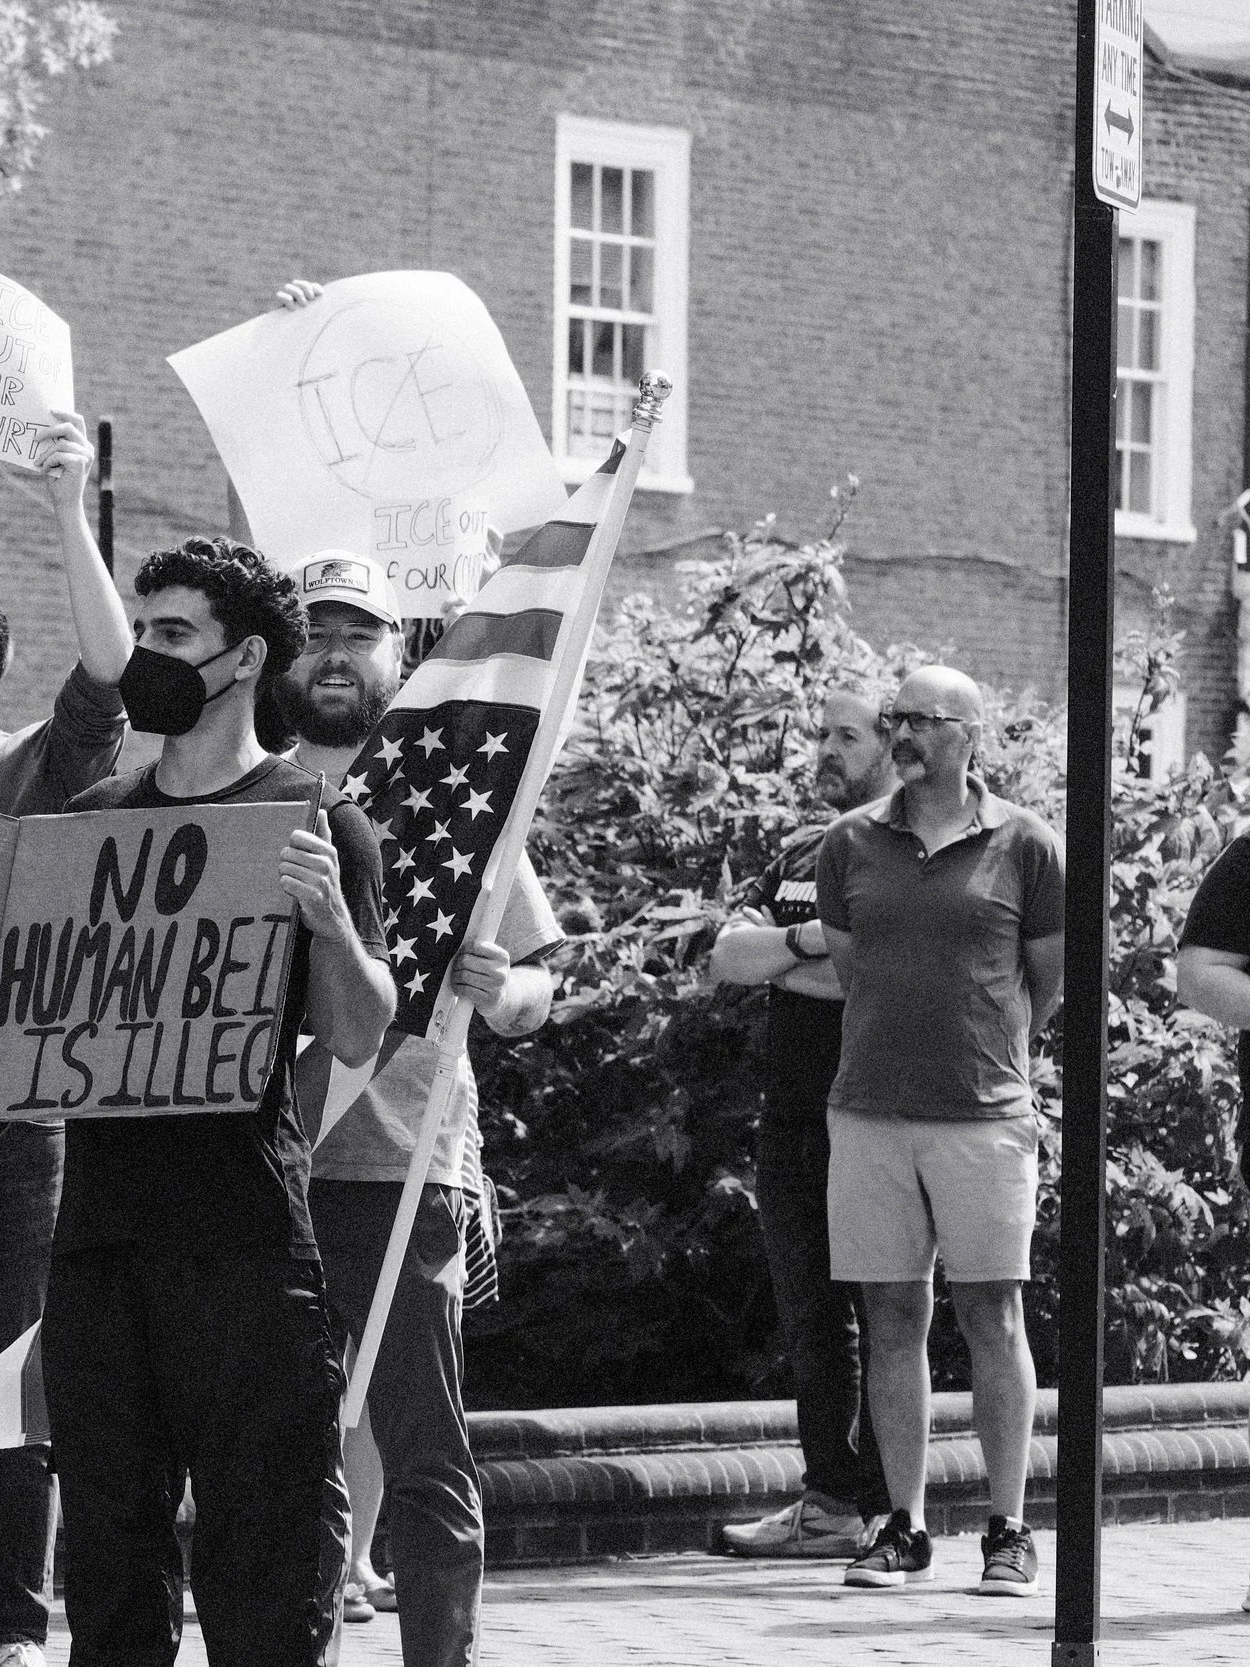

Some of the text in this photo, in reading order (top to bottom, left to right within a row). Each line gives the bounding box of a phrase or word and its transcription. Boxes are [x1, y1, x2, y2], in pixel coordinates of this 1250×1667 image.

[1101, 41, 1137, 97] ANY TIME
[1101, 147, 1136, 192] TOW-AWAY
[295, 343, 470, 467] ICE
[374, 497, 488, 551] ICE OUT
[404, 563, 451, 591] OUR
[89, 822, 208, 927] NO
[6, 1020, 99, 1112] IS
